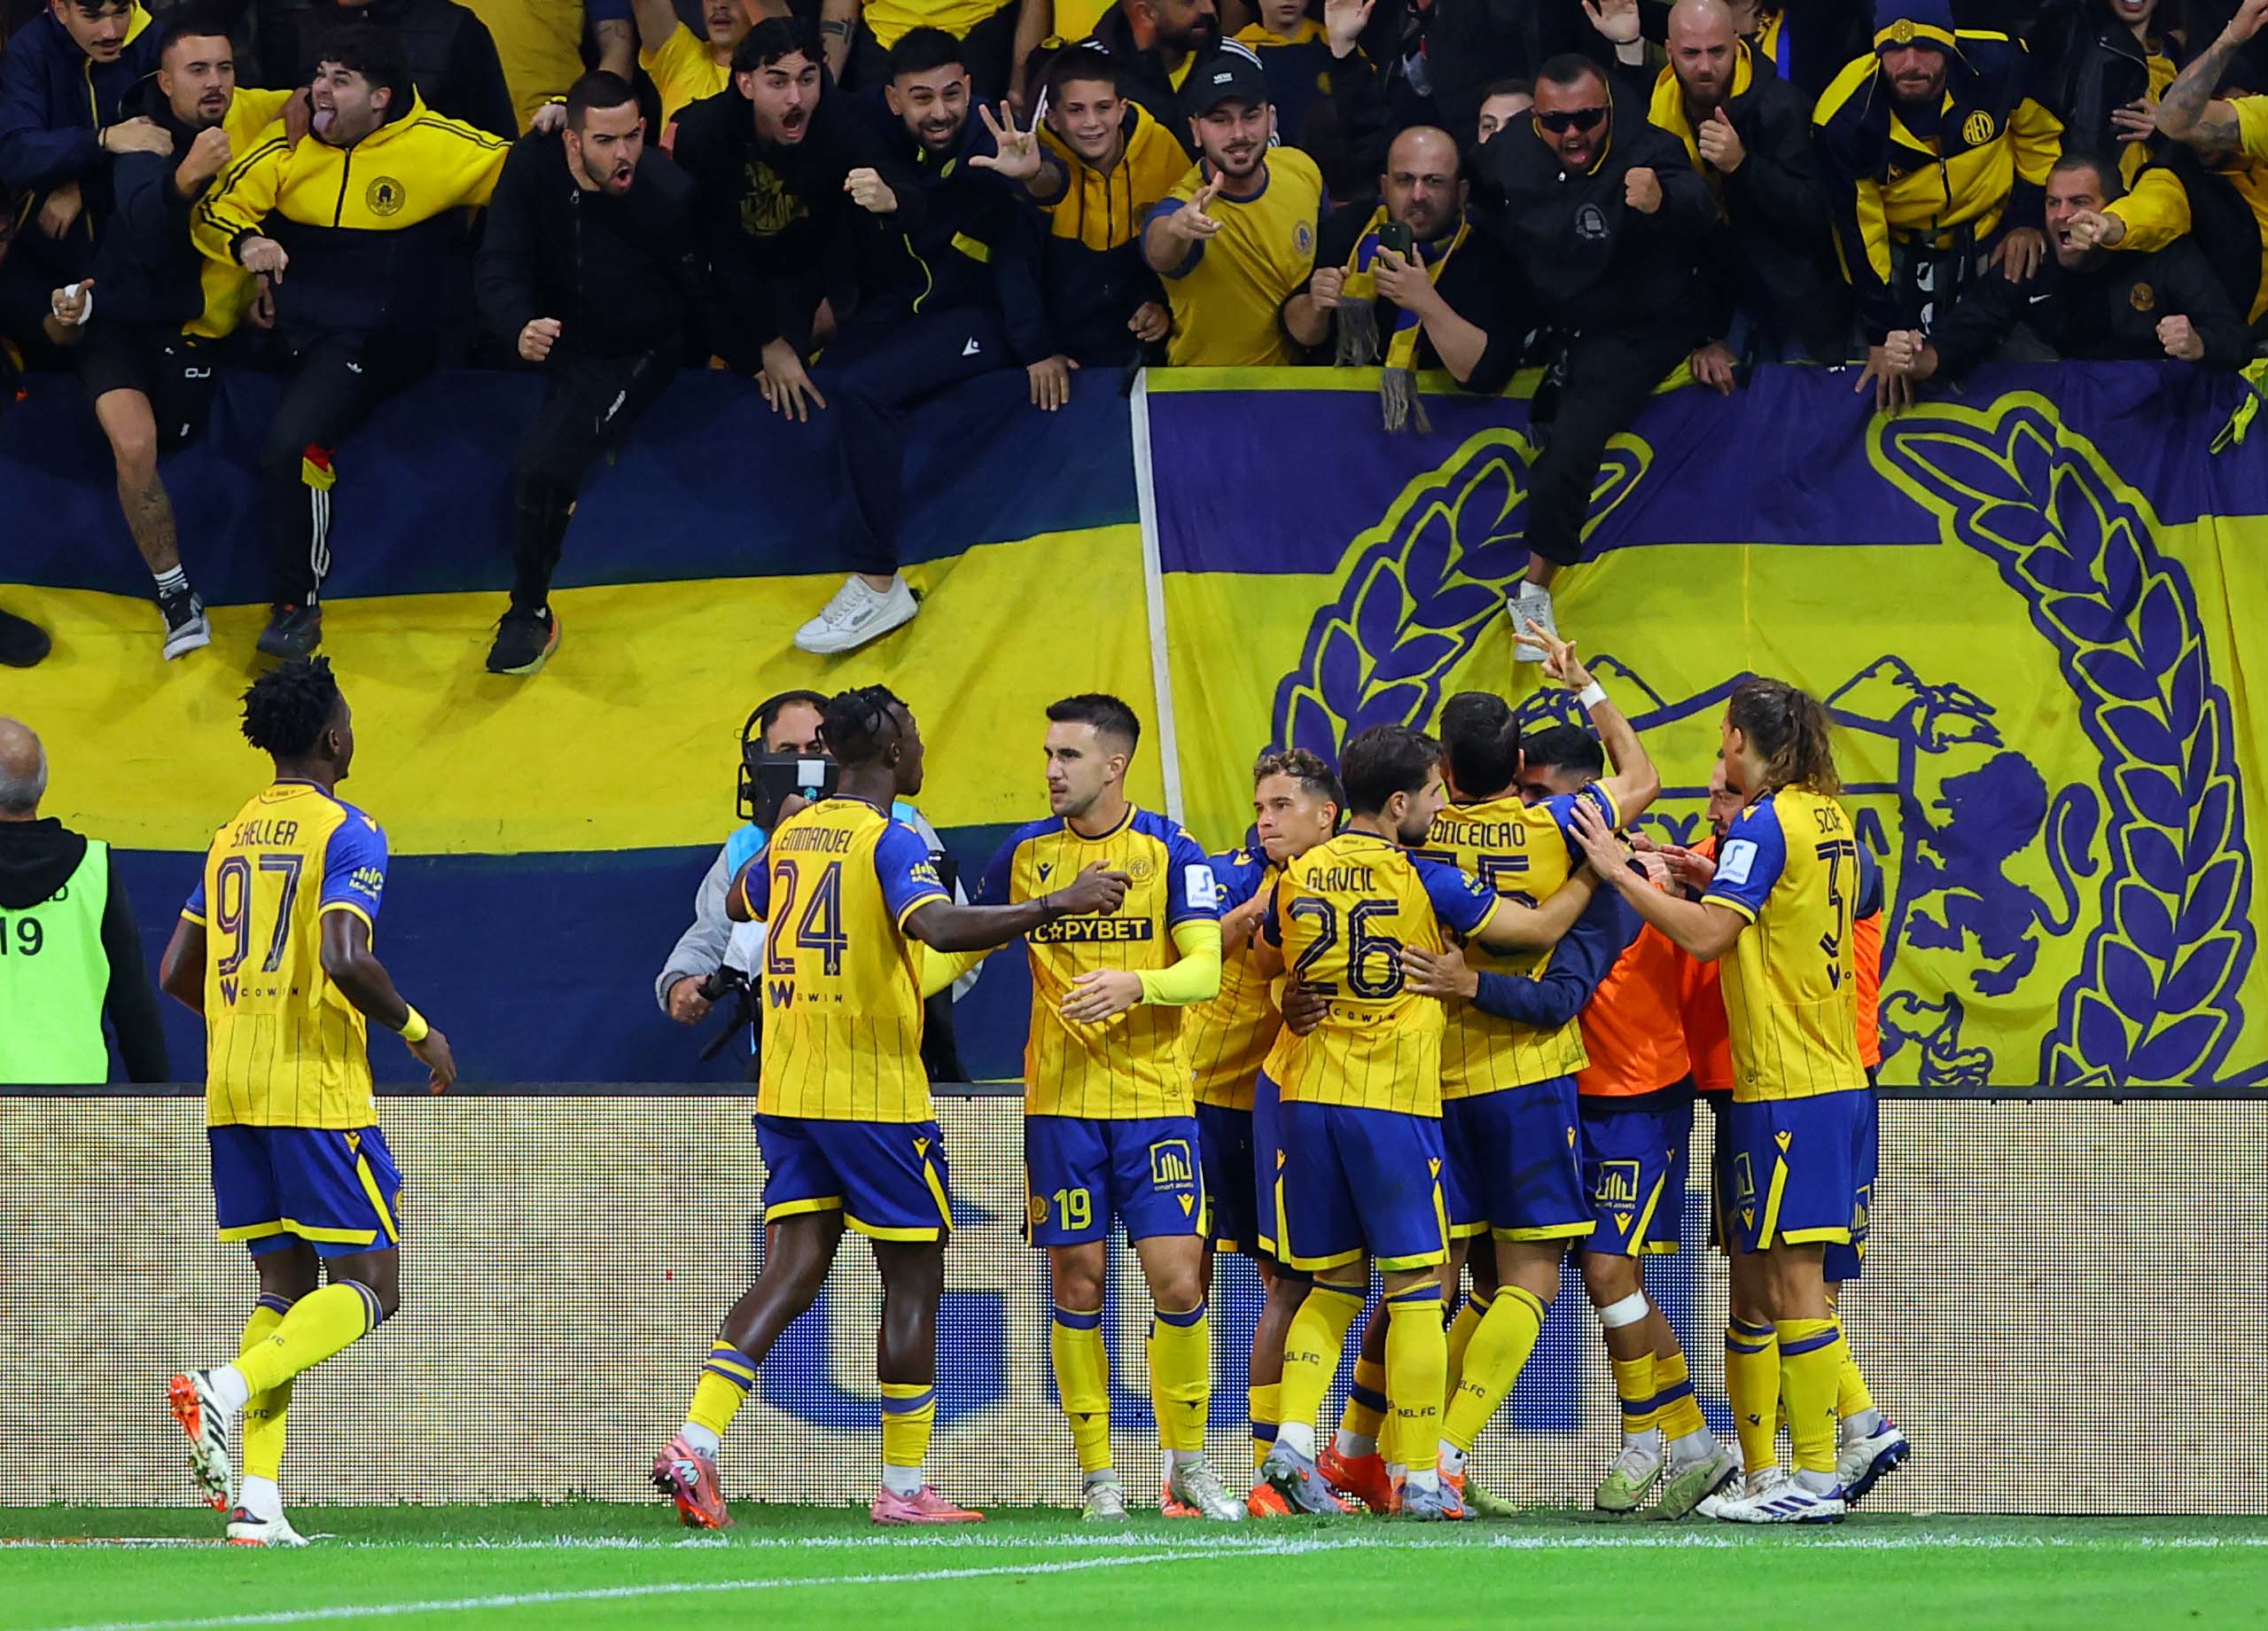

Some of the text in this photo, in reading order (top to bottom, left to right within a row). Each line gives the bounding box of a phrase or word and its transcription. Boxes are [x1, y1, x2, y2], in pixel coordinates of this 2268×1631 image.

[1423, 820, 1526, 848] ONCEICAO
[1305, 867, 1377, 893] GLAVCIC
[217, 854, 305, 978] 97
[768, 859, 848, 977] 24
[1286, 896, 1406, 999] 26
[1052, 1187, 1092, 1231] 19
[1301, 1351, 1321, 1366] FC
[1469, 1384, 1486, 1399] FC
[1397, 1406, 1437, 1418] AEL FC
